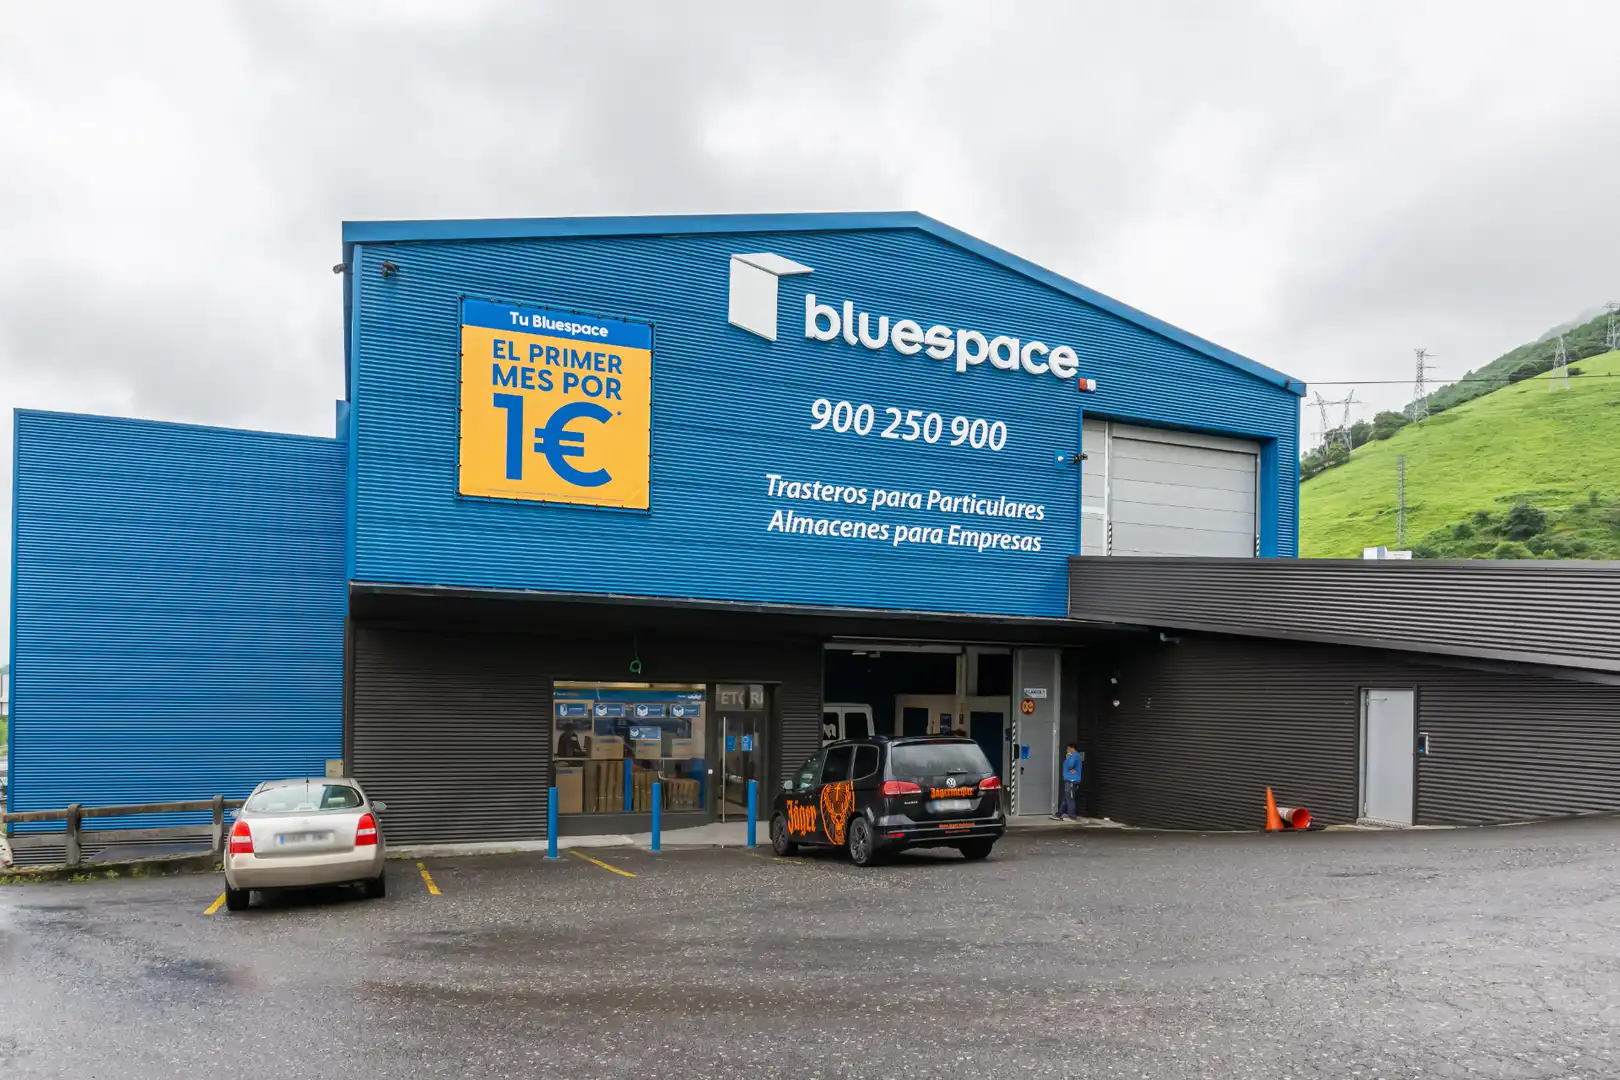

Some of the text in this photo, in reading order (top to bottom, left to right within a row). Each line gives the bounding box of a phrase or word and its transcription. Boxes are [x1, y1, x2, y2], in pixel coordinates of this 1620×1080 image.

[509, 311, 609, 337] Tu Bluespace
[805, 294, 1079, 379] bluespace
[493, 339, 623, 375] EL PRIMER
[492, 363, 622, 400] MES POR
[810, 398, 1008, 451] 900 250 900
[766, 474, 1045, 521] Trasteros para Particulares
[767, 510, 1042, 553] Almacenes para Empresas
[786, 799, 817, 836] Jäger
